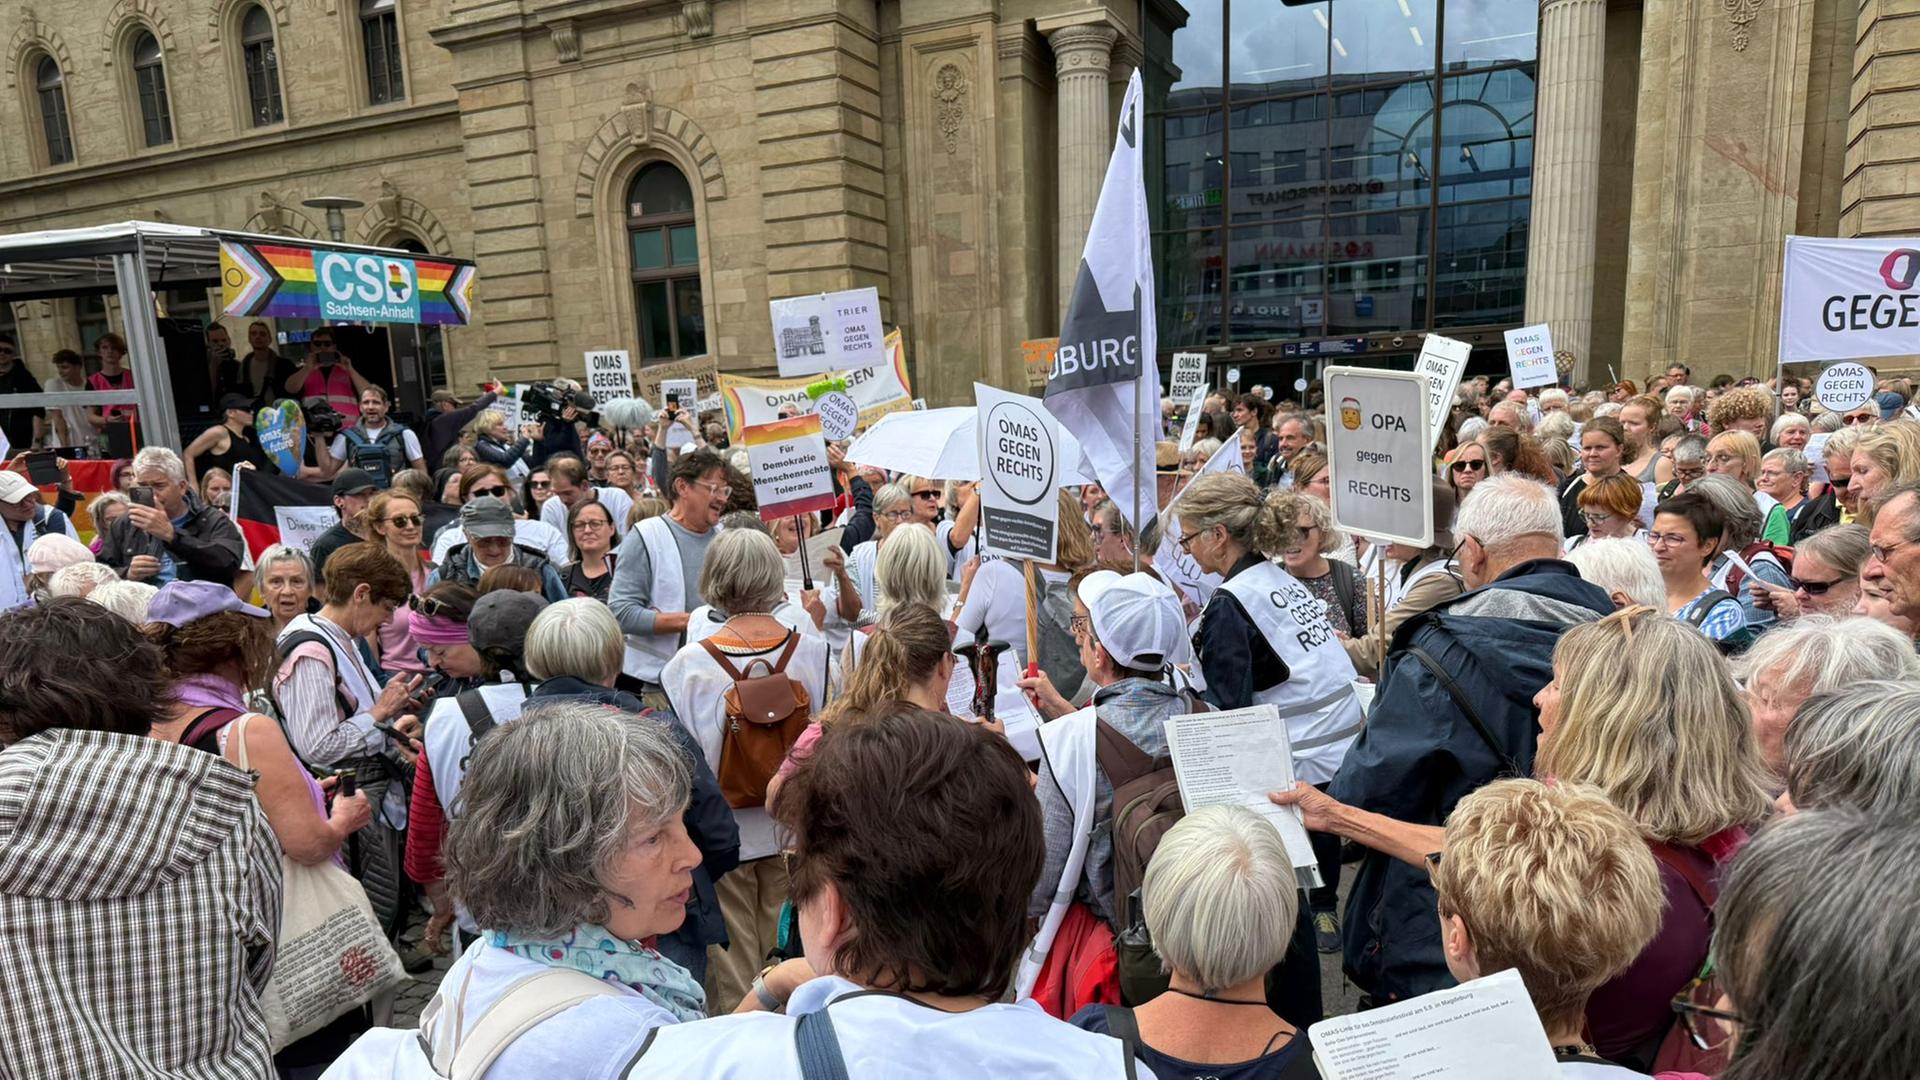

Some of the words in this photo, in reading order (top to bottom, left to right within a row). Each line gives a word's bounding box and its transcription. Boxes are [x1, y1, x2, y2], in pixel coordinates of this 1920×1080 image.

[321, 253, 412, 304] CSD
[326, 301, 415, 319] Sachsen-Anhalt
[837, 305, 868, 317] TRIER
[1822, 294, 1920, 333] GEGE
[844, 324, 866, 334] OMAS
[843, 333, 870, 344] GEGEN
[1513, 334, 1541, 345] OMAS
[842, 342, 873, 352] RECHTS
[1515, 345, 1544, 358] GEGEN
[593, 355, 622, 370] OMAS
[1179, 357, 1201, 369] OMAS
[1425, 359, 1449, 376] OMAS
[1515, 356, 1550, 369] RECHTS
[845, 366, 876, 389] GEN
[1175, 371, 1201, 383] GEGEN
[1827, 367, 1864, 377] OMAS
[593, 373, 628, 388] GEGEN
[1824, 380, 1865, 390] GEGEN
[1172, 385, 1198, 397] RECHT
[1821, 392, 1867, 403] RECHTS
[765, 391, 811, 408] OMA
[828, 393, 856, 416] OMAS
[820, 402, 850, 428] GEGEN
[1371, 413, 1407, 433] OPA
[998, 418, 1039, 443] OMAS
[779, 445, 795, 455] Für
[998, 437, 1042, 464] GEGEN
[1356, 449, 1393, 464] gegen
[762, 454, 816, 471] Demokratie
[996, 456, 1044, 483] RECHTS
[753, 465, 830, 486] Menschenrechte
[774, 481, 813, 495] Toleranz
[1347, 479, 1412, 503] RECHTS
[286, 516, 316, 532] Diese
[1270, 583, 1307, 609] OMAS
[1290, 600, 1323, 626] GEGE
[1296, 619, 1336, 652] RECH
